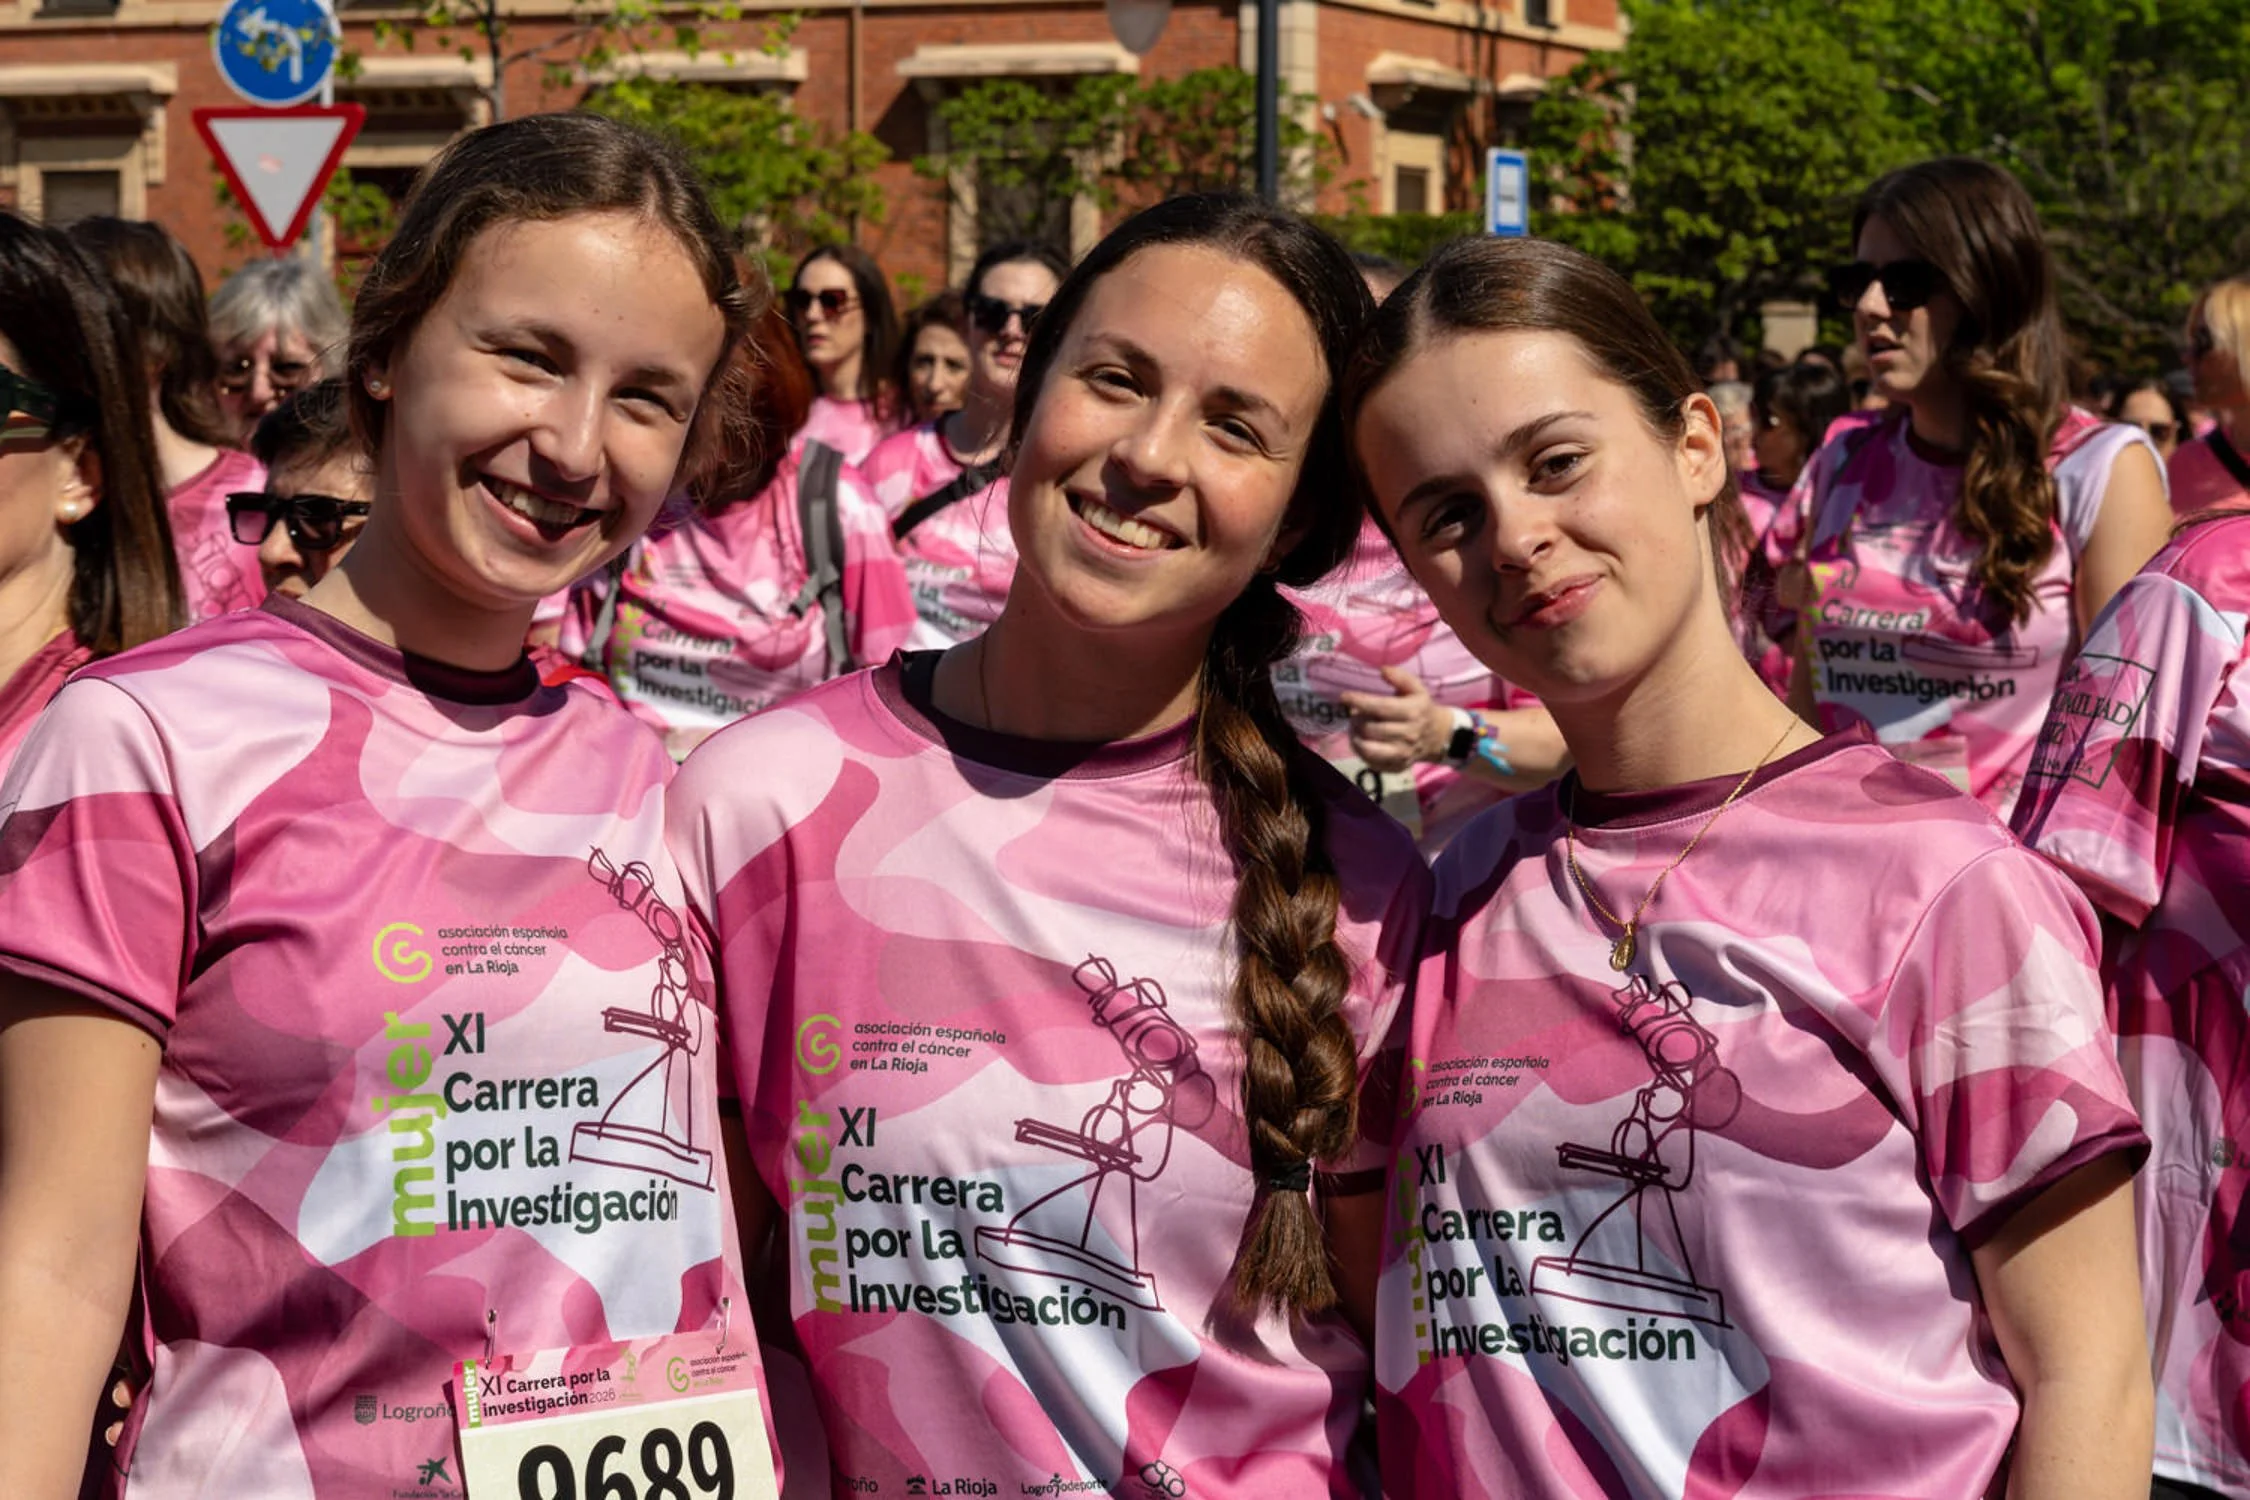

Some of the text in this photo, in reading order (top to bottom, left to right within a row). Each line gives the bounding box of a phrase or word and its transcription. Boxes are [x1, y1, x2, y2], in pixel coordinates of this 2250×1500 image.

[1821, 597, 1925, 631] Carrera
[635, 651, 703, 675] por la
[1817, 635, 1897, 662] por la
[1827, 667, 2016, 704] Investigación
[438, 924, 569, 941] asociación española
[441, 942, 547, 956] contra el cáncer
[445, 960, 519, 977] en La Rioja
[441, 1011, 486, 1056] XI
[852, 1037, 972, 1058] contra el cáncer
[854, 1021, 1007, 1045] asociación española
[850, 1056, 928, 1075] en La Rioja
[1425, 1075, 1460, 1091] contra
[1462, 1073, 1473, 1087] el
[1431, 1055, 1550, 1073] asociación española
[443, 1071, 600, 1113] Carrera
[1436, 1092, 1450, 1106] La
[1451, 1091, 1483, 1107] Rioja
[371, 1010, 446, 1239] mujer
[838, 1106, 876, 1148] XI
[445, 1125, 561, 1185] por la
[1415, 1143, 1447, 1187] XI
[841, 1163, 1005, 1214] Carrera
[446, 1179, 679, 1236] Investigación
[790, 1100, 846, 1315] mujer
[1421, 1203, 1566, 1243] Carrera
[845, 1219, 967, 1268] por la
[849, 1273, 1128, 1331] Investigación
[1426, 1255, 1526, 1313] por la
[1430, 1314, 1697, 1367] Investigación
[463, 1366, 481, 1424] mujer
[480, 1367, 611, 1398] XI Carrera por la
[382, 1403, 454, 1423] Logroño
[483, 1388, 617, 1417] investigación 2026
[518, 1421, 735, 1500] 9689
[932, 1478, 997, 1498] La Rioja
